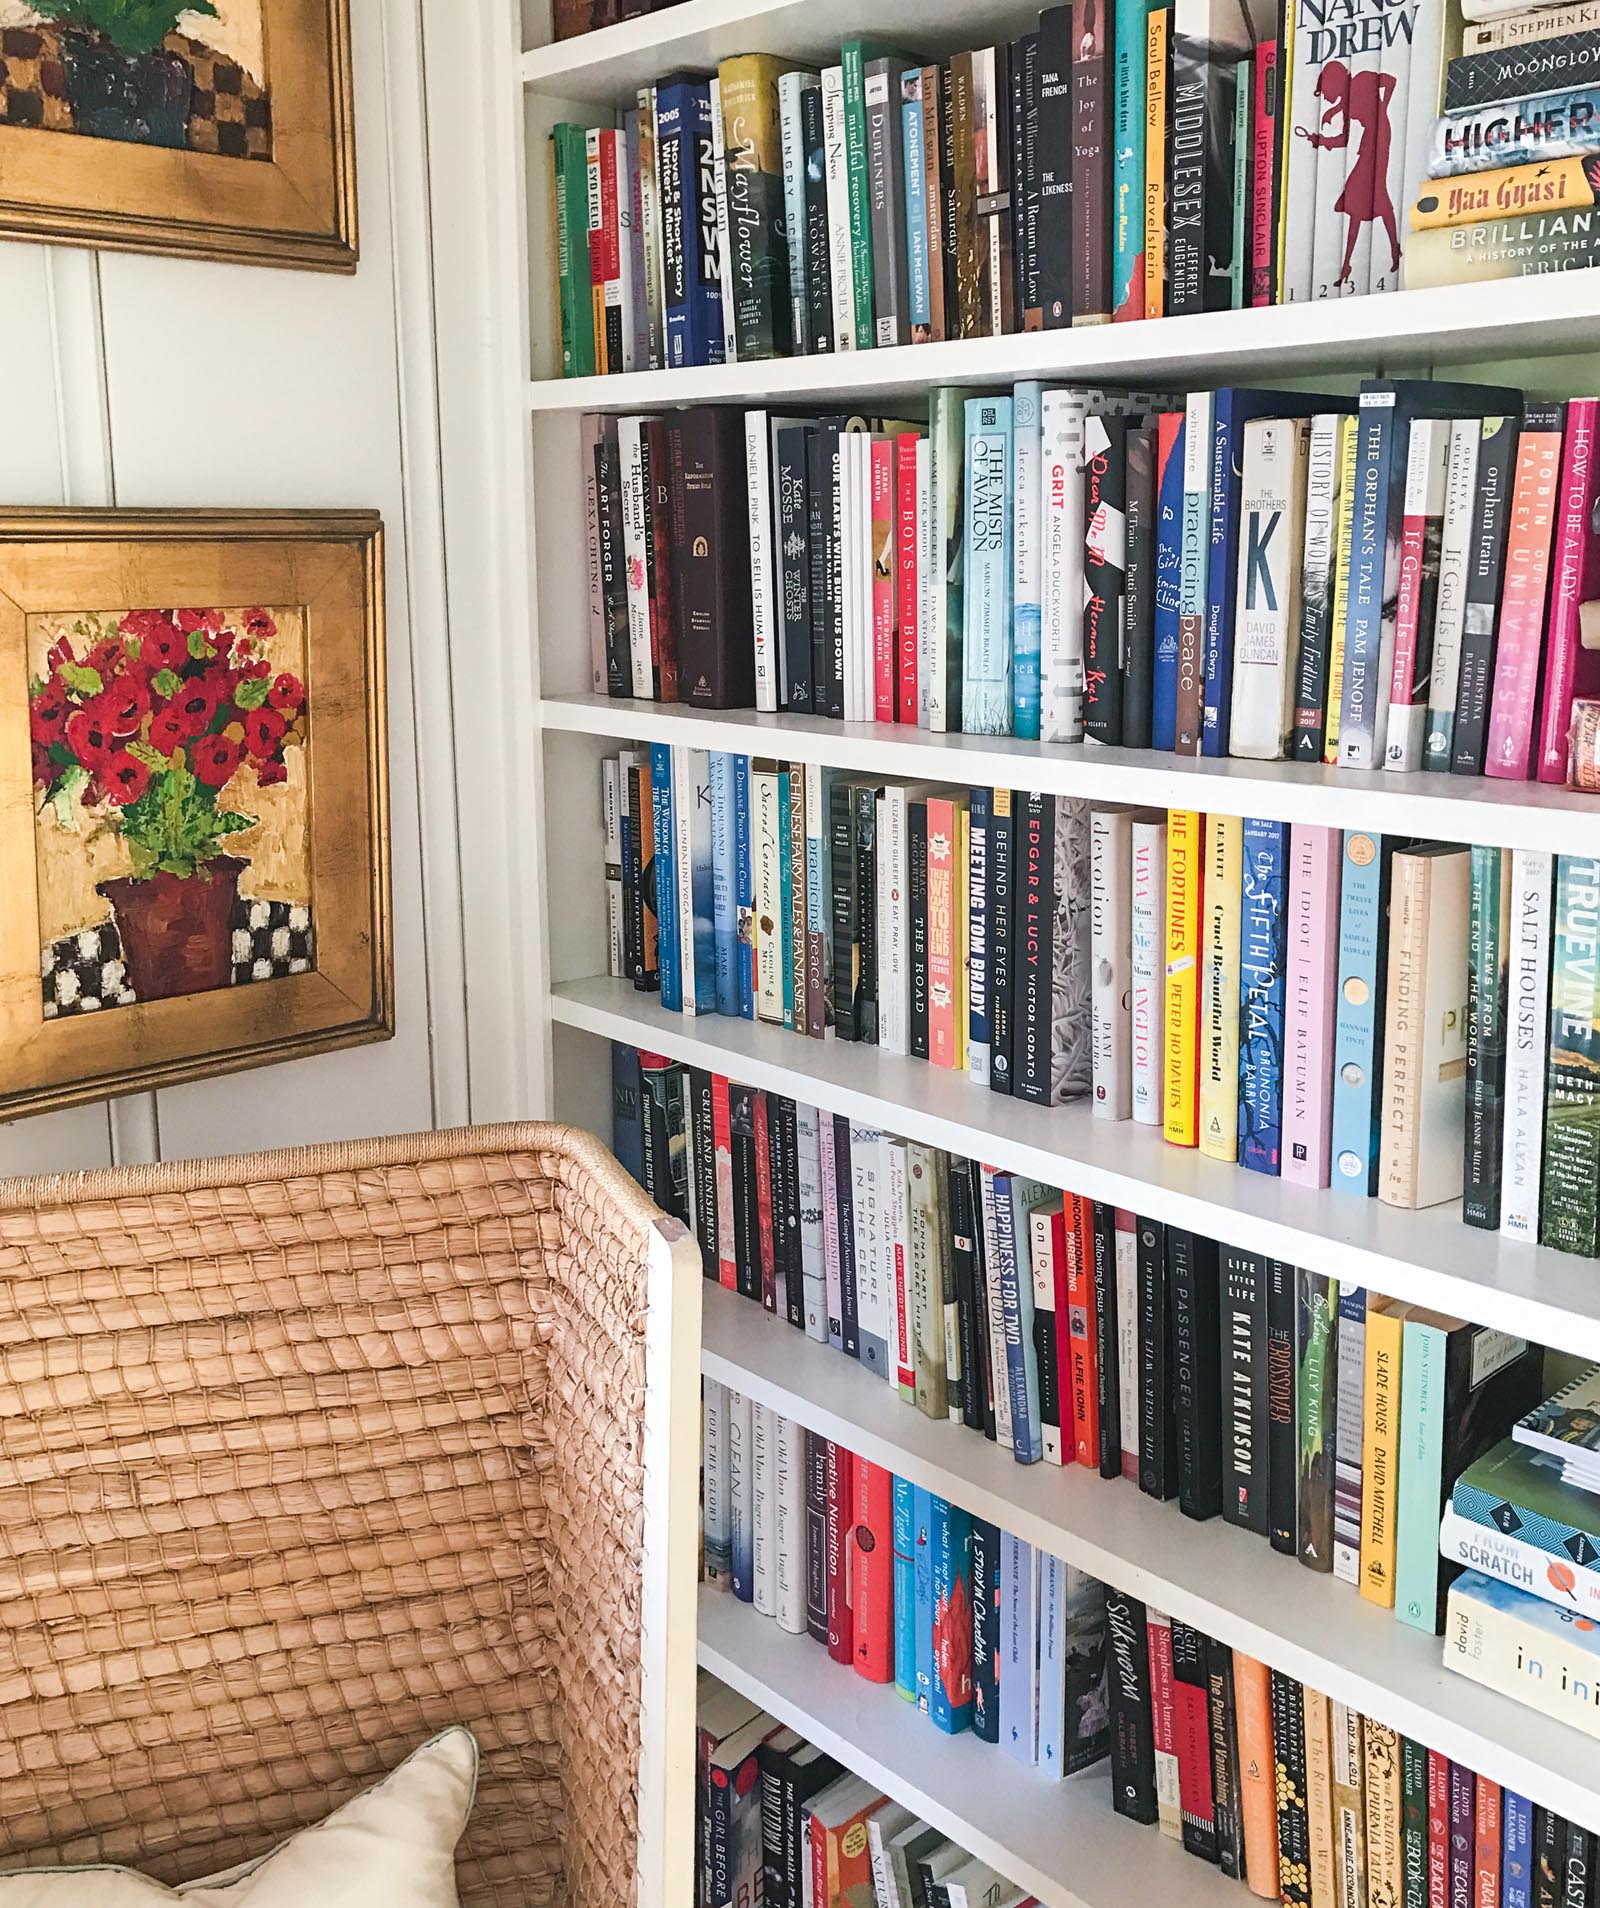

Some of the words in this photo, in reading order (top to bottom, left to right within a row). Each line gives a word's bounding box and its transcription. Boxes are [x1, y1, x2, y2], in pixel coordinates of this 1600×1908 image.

[1149, 25, 1162, 64] Saul
[1306, 5, 1420, 64] DREW
[1510, 15, 1576, 37] STEPHEN
[1041, 85, 1067, 97] FRENCH
[1149, 71, 1163, 127] Bellow
[658, 111, 679, 123] 2005
[671, 139, 680, 189] Novel
[849, 114, 863, 171] mindful
[871, 114, 885, 210] DUBLINERS
[908, 111, 920, 196] ATONEMENT
[1173, 82, 1205, 230] MIDDLESEX
[1256, 130, 1268, 183] UPTON
[589, 166, 598, 191] SYD
[674, 192, 681, 202] &
[732, 117, 759, 287] Mayflower
[1027, 191, 1038, 200] A
[1042, 184, 1072, 195] LIKENESS
[1449, 187, 1489, 218] Yaa
[1497, 173, 1566, 209] Gyasi
[590, 194, 599, 227] FIELD
[674, 207, 682, 251] Short
[850, 176, 862, 236] recovery
[928, 184, 939, 251] amsterdam
[1027, 206, 1040, 249] Return
[1255, 187, 1267, 257] SINCLAIR
[913, 231, 922, 253] IAN
[1147, 184, 1159, 279] Ravelstein
[675, 255, 684, 297] Story
[809, 205, 822, 309] SLOWNESS
[1028, 254, 1038, 266] to
[1173, 238, 1186, 304] EUGENIDES
[1186, 245, 1199, 294] JEFFREY
[914, 257, 925, 313] McEWAN
[1029, 271, 1040, 302] Love
[1216, 421, 1226, 432] A
[1367, 425, 1381, 460] THE
[974, 441, 988, 466] OF
[988, 448, 1002, 484] THE
[1018, 448, 1029, 490] decca
[1212, 437, 1226, 512] Sustainable
[1312, 432, 1333, 499] HISTORY
[600, 484, 609, 511] ART
[781, 466, 792, 523] MOSSE
[792, 478, 803, 509] Kate
[1052, 465, 1064, 508] GRIT
[1245, 500, 1287, 511] BROTHERS
[1480, 467, 1499, 529] orphan
[1516, 443, 1536, 532] TALLEY
[1535, 451, 1554, 525] ROBIN
[973, 471, 988, 552] AVALON
[988, 494, 1002, 550] MISTS
[1212, 517, 1224, 544] Life
[1310, 509, 1330, 526] OF
[1361, 468, 1379, 554] ORPHAN'S
[602, 520, 612, 581] FORGER
[903, 511, 914, 570] BOYS
[1018, 499, 1029, 584] aitkenhead
[1052, 516, 1062, 566] ANGELA
[1179, 491, 1200, 615] practicing
[1246, 511, 1282, 611] K
[1405, 530, 1419, 551] If
[1478, 536, 1496, 576] train
[1307, 536, 1328, 597] WOLVES
[1358, 563, 1372, 604] TALE
[1399, 556, 1416, 612] Grace
[1051, 571, 1062, 651] DUCKWORTH
[1209, 605, 1220, 647] Douglas
[1246, 622, 1276, 634] DAVID
[1301, 606, 1323, 643] Emily
[1399, 623, 1412, 639] Is
[903, 625, 914, 685] BOAT
[1177, 616, 1198, 690] peace
[1239, 648, 1279, 661] DUNCAN
[1354, 620, 1368, 654] PAM
[1497, 548, 1529, 726] UNIVERSE
[1208, 650, 1218, 680] Gwyn
[1301, 646, 1321, 699] Fridlund
[1393, 645, 1411, 690] True
[1350, 659, 1366, 721] JENOFF
[970, 827, 985, 909] MEETING
[996, 831, 1006, 896] BEHIND
[1028, 819, 1040, 887] EDGAR
[1216, 822, 1225, 881] LEAVITT
[1302, 840, 1313, 878] THE
[1029, 893, 1039, 905] &
[1093, 821, 1109, 937] devotion
[1171, 849, 1185, 951] FORTUNES
[915, 918, 923, 956] THE
[970, 914, 985, 953] TOM
[996, 905, 1006, 937] HER
[1027, 914, 1038, 966] LUCY
[1212, 905, 1224, 950] Cruel
[1299, 892, 1312, 946] IDIOT
[1520, 891, 1540, 949] SALT
[996, 946, 1006, 986] EYES
[1561, 858, 1600, 1040] TRUEVINE
[916, 963, 924, 1013] ROAD
[970, 958, 984, 1016] BRADY
[1028, 974, 1036, 1021] VICTOR
[1170, 984, 1182, 1028] PETER
[1211, 955, 1224, 1030] Beautiful
[1297, 976, 1309, 1018] ELIF
[1396, 951, 1411, 1031] FINDING
[1517, 957, 1536, 1050] HOUSES
[1027, 1027, 1036, 1077] LODATO
[1170, 1033, 1182, 1055] HO
[1211, 1036, 1222, 1081] World
[1170, 1060, 1181, 1108] DAVIES
[1245, 1064, 1257, 1107] BARRY
[1259, 1050, 1271, 1129] BRUNONIA
[1295, 1029, 1307, 1120] BATUMAN
[1392, 1044, 1407, 1132] PERFECT
[1555, 1089, 1595, 1105] MACY
[1558, 1075, 1594, 1089] BETH
[702, 1089, 712, 1131] CRIME
[785, 1116, 794, 1143] MEG
[704, 1136, 712, 1162] AND
[787, 1148, 795, 1210] WOLITZER
[705, 1168, 715, 1252] PUNISHMENT
[995, 1195, 1017, 1276] HAPPINESS
[1066, 1232, 1077, 1291] PARENTING
[1001, 1281, 1018, 1310] FOR
[1005, 1315, 1020, 1344] TWO
[1233, 1312, 1251, 1362] KATE
[1075, 1353, 1084, 1385] ALFIE
[1309, 1358, 1318, 1391] LILY
[1376, 1351, 1389, 1389] SLADE
[1077, 1389, 1085, 1421] KOHN
[1233, 1371, 1251, 1475] ATKINSON
[1308, 1398, 1318, 1437] KING
[1376, 1393, 1388, 1435] HOUSE
[1374, 1447, 1386, 1483] DAVID
[1372, 1488, 1384, 1544] MITCHELL
[829, 1505, 839, 1576] Nutrition
[1459, 1541, 1533, 1586] SCRATCH
[1158, 1629, 1171, 1683] Sleepless
[1162, 1687, 1171, 1699] in
[1211, 1674, 1224, 1694] The
[1162, 1705, 1174, 1749] America
[1212, 1697, 1225, 1729] Point
[1214, 1733, 1227, 1746] of
[1214, 1749, 1228, 1806] Vanishing
[1405, 1743, 1413, 1796] ALEXANDER
[716, 1810, 726, 1839] GIRL
[762, 1772, 782, 1855] DARKTOWN
[1368, 1763, 1380, 1845] CALPURNIA
[716, 1845, 726, 1897] BEFORE
[1371, 1851, 1380, 1886] TATE
